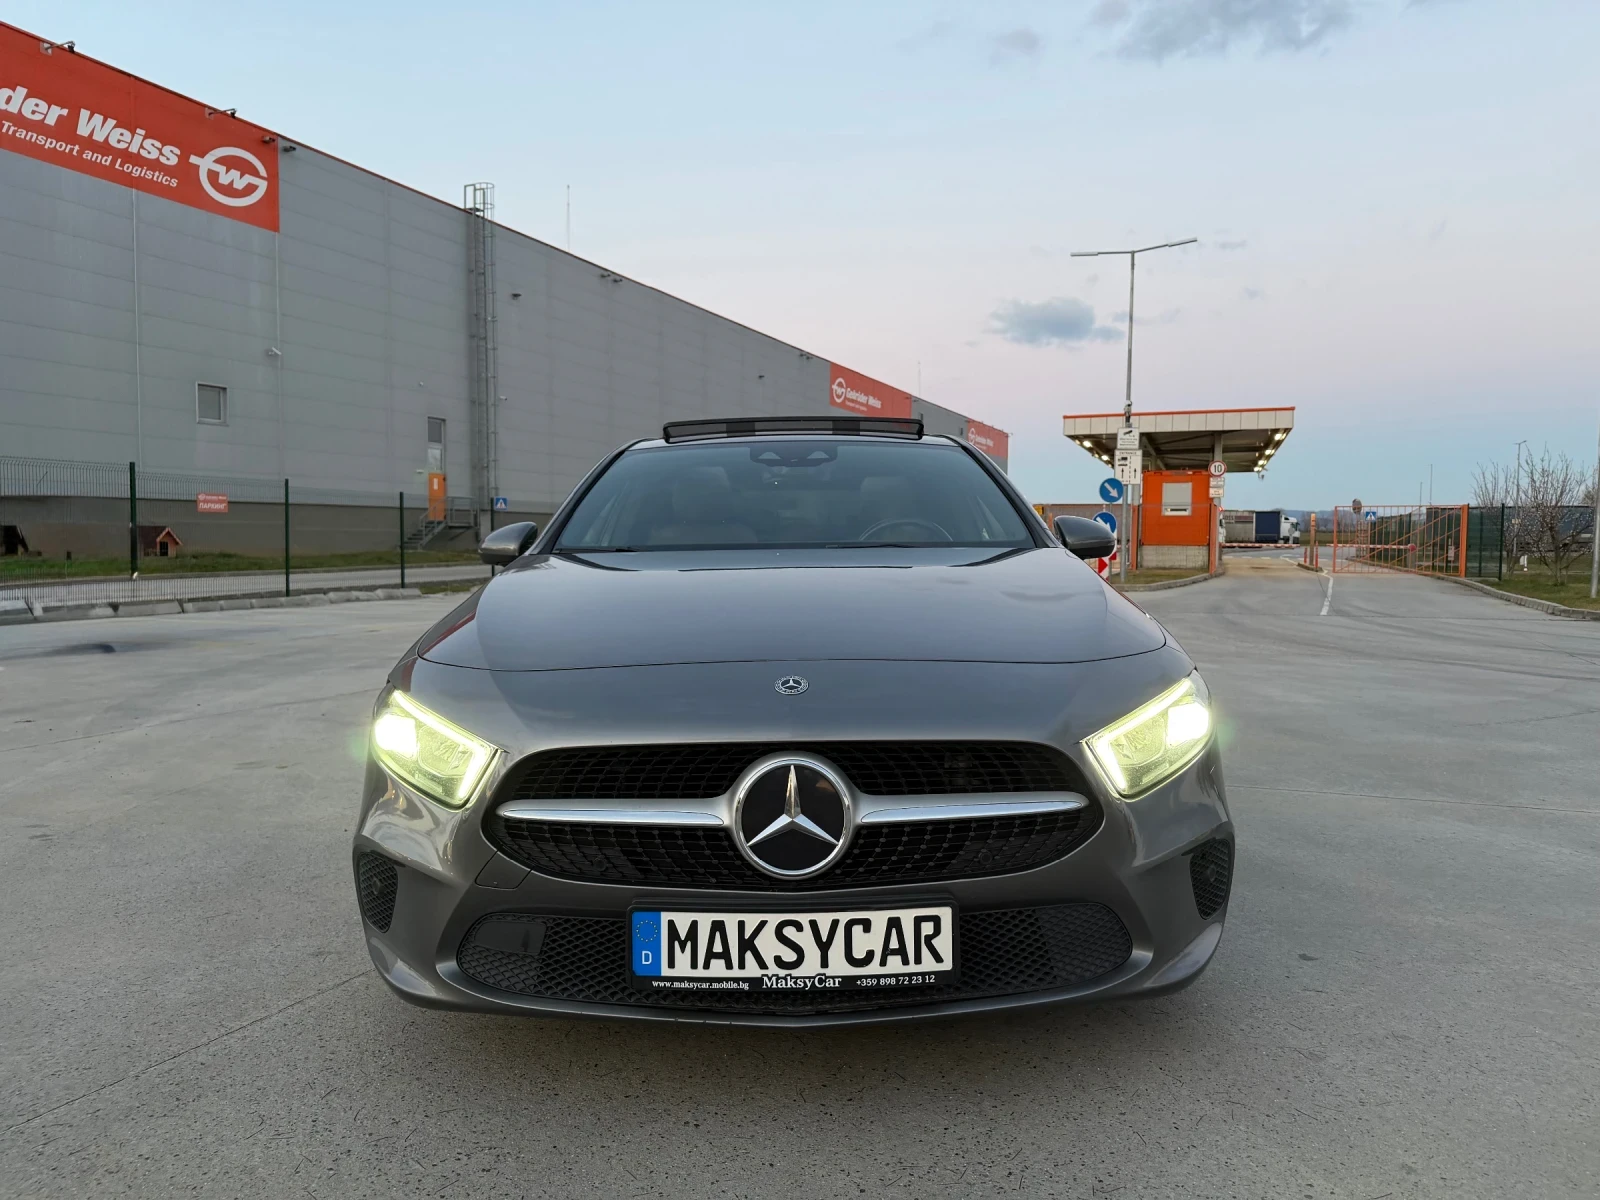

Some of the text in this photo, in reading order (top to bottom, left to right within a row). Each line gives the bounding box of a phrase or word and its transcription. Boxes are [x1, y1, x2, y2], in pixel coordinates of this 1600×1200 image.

[76, 108, 180, 166] Weiss
[2, 120, 179, 187] Transport and Logistics
[1213, 464, 1223, 473] 10
[667, 914, 945, 971] MAKSYCAR
[641, 951, 653, 965] D
[652, 980, 750, 990] www.maksycar.mobile.bg
[762, 974, 842, 990] MaksyCar
[856, 975, 936, 987] +359 898 72 23 12
